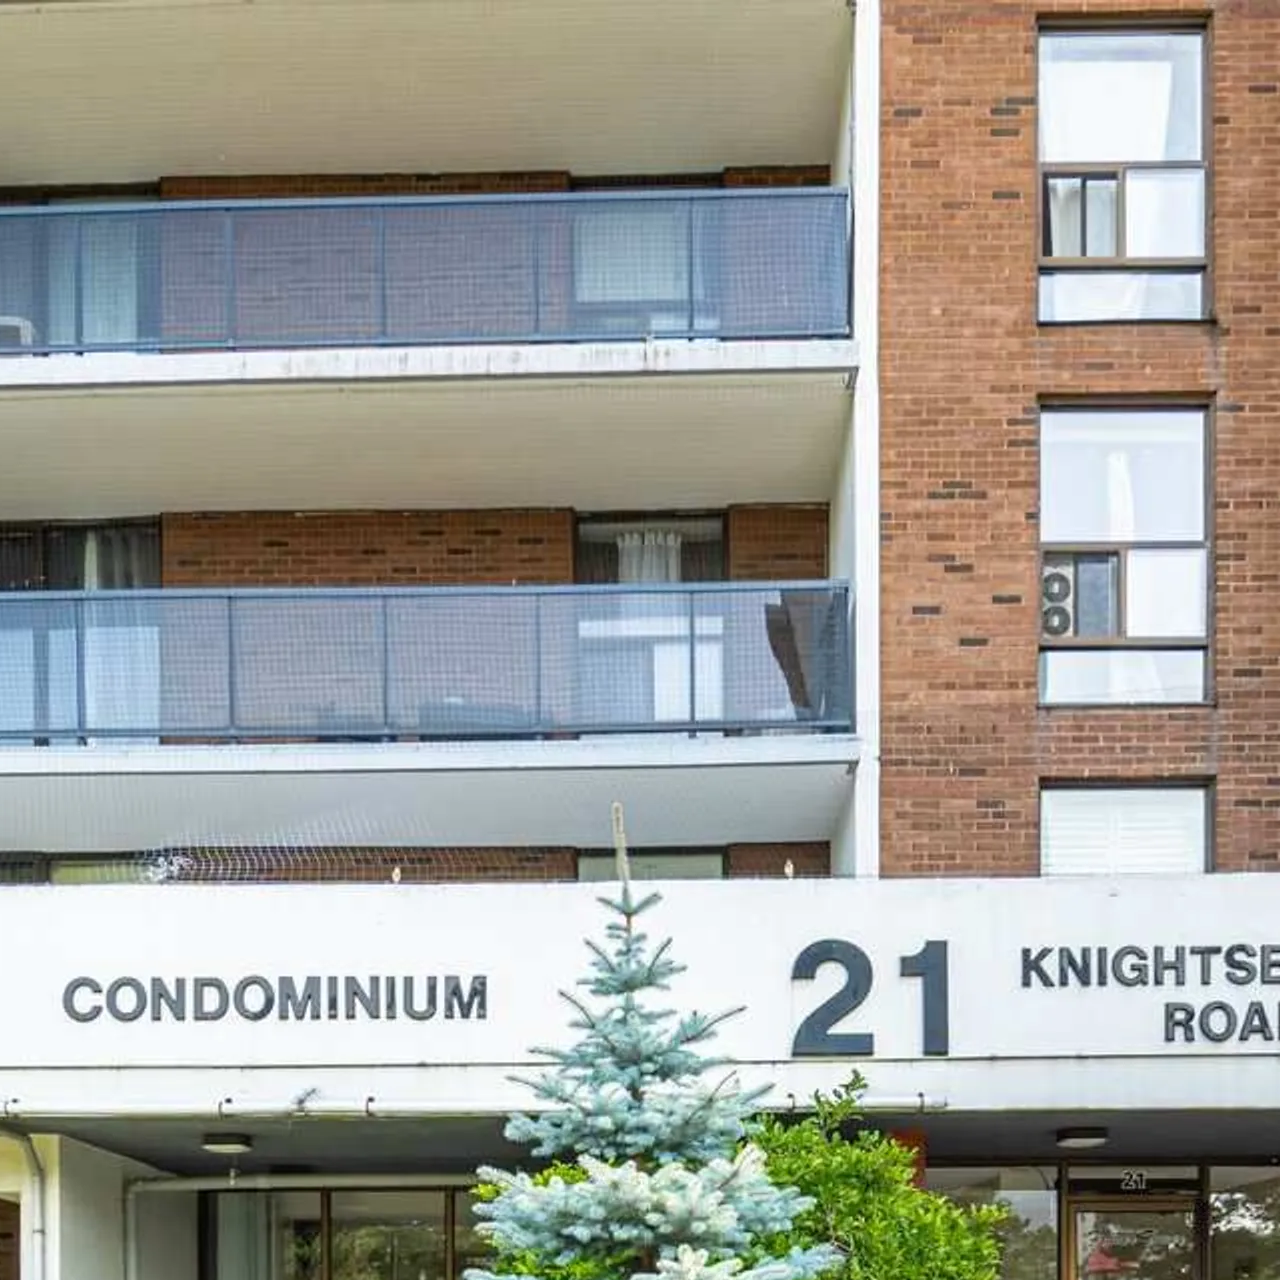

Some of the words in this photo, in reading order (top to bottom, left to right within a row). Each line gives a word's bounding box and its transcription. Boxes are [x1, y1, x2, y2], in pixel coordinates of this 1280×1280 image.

[62, 975, 488, 1023] CONDOMINIUM
[791, 938, 950, 1057] 21
[1121, 1170, 1147, 1190] 21
